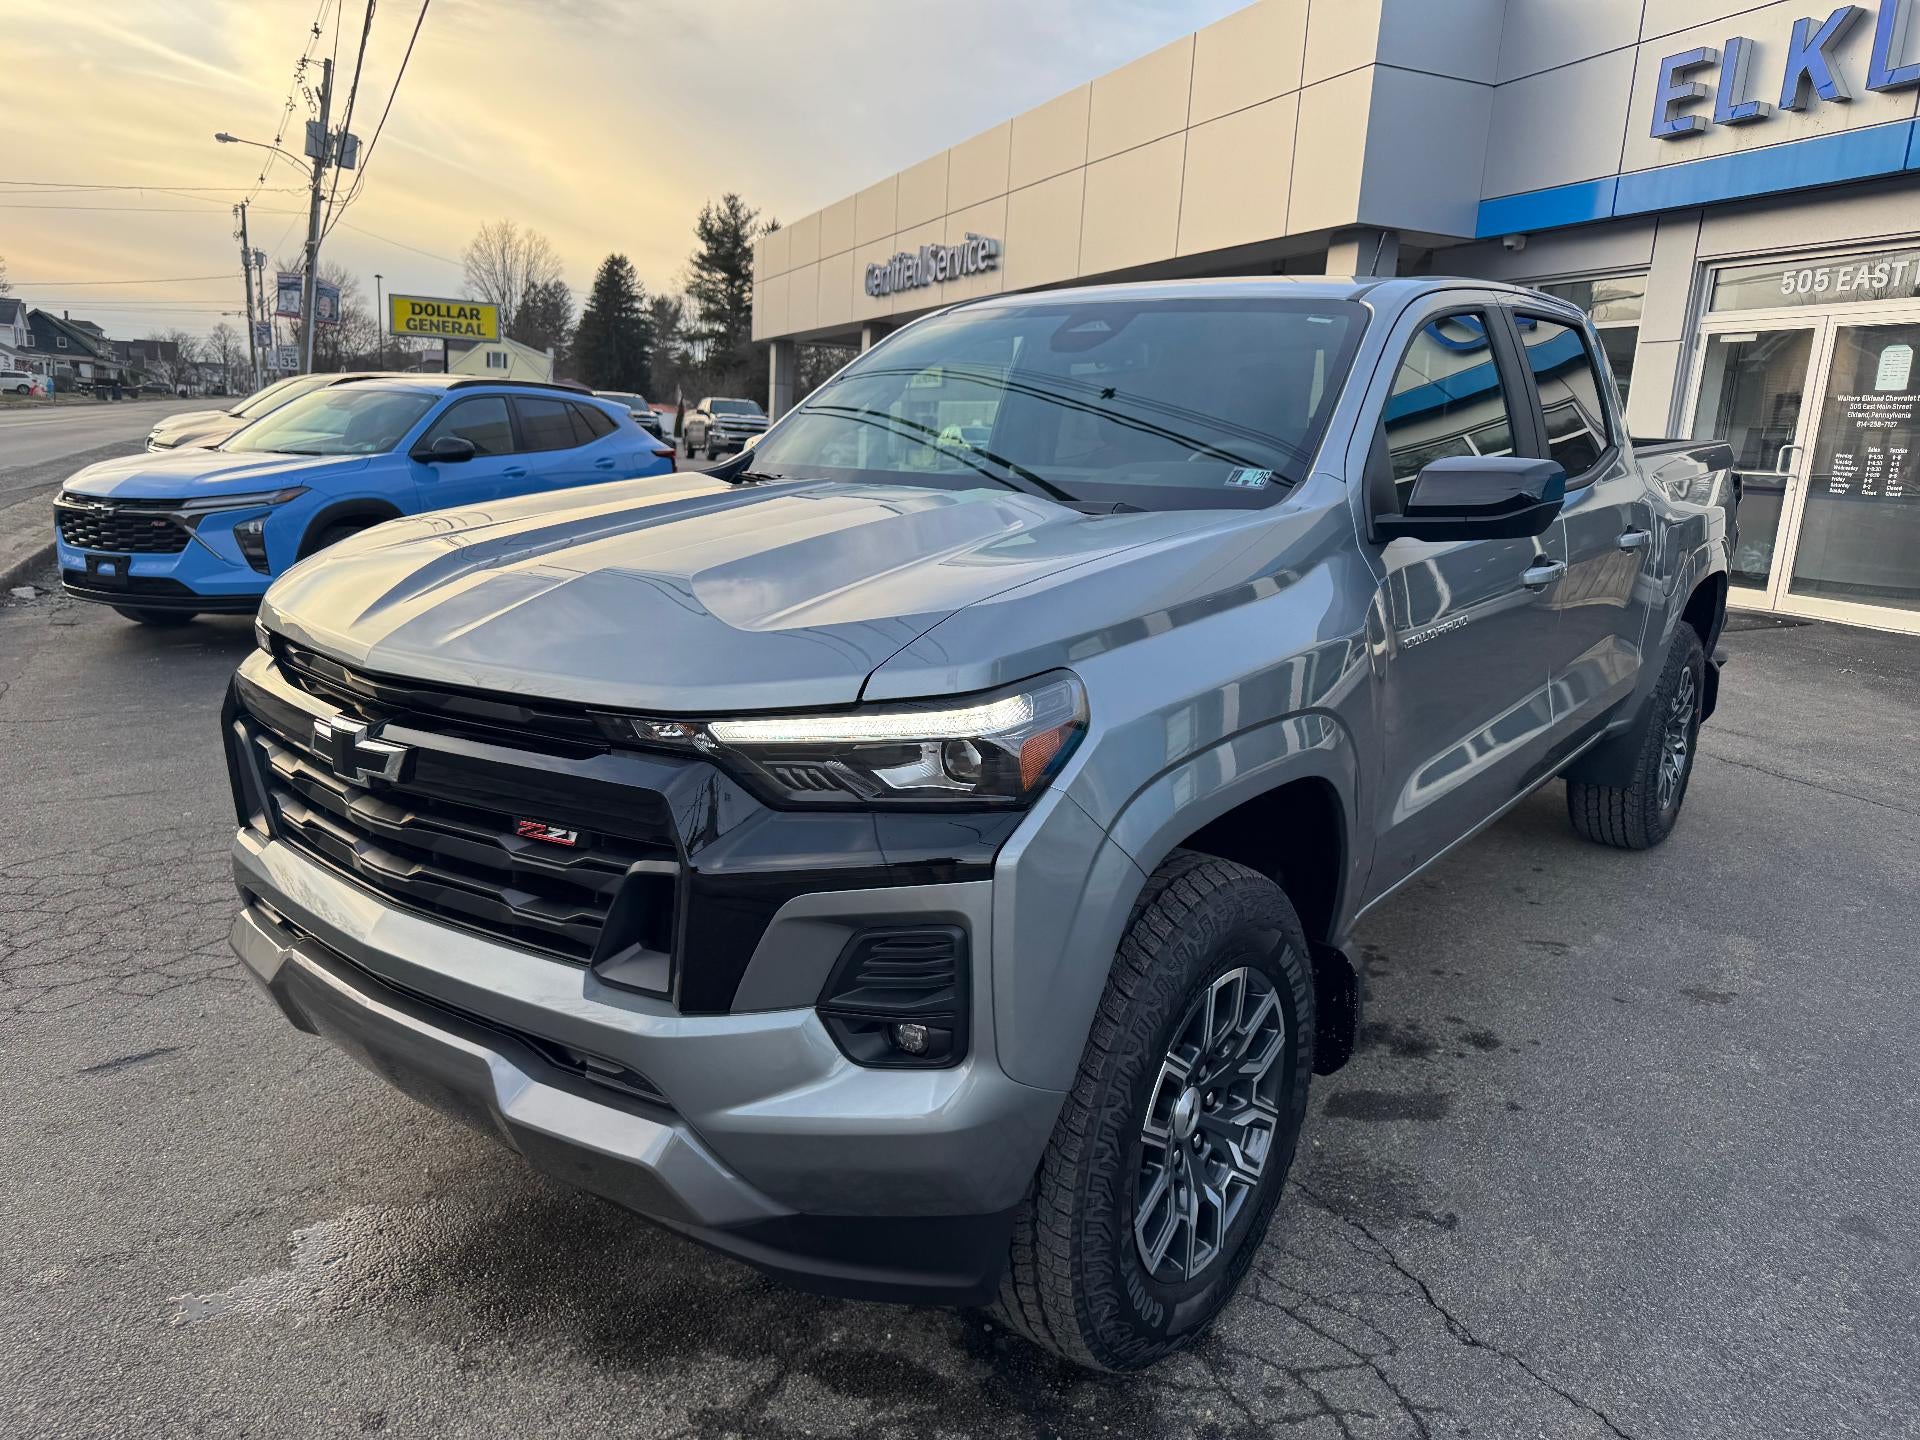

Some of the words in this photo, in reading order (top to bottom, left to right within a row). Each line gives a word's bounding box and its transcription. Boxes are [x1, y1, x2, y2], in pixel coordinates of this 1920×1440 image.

[865, 247, 925, 297] Certified
[927, 232, 996, 283] Service
[1781, 267, 1831, 295] 505
[1836, 260, 1910, 292] EAST
[410, 302, 482, 320] DOLLAR
[405, 318, 486, 336] GENERAL
[281, 357, 298, 368] 35
[1837, 394, 1861, 402] Walters
[1862, 394, 1885, 402] Elkland
[1885, 394, 1917, 402] Chevrolet
[1871, 411, 1912, 420] Pennsylvania
[1254, 471, 1271, 486] 26
[516, 819, 578, 847] Z71
